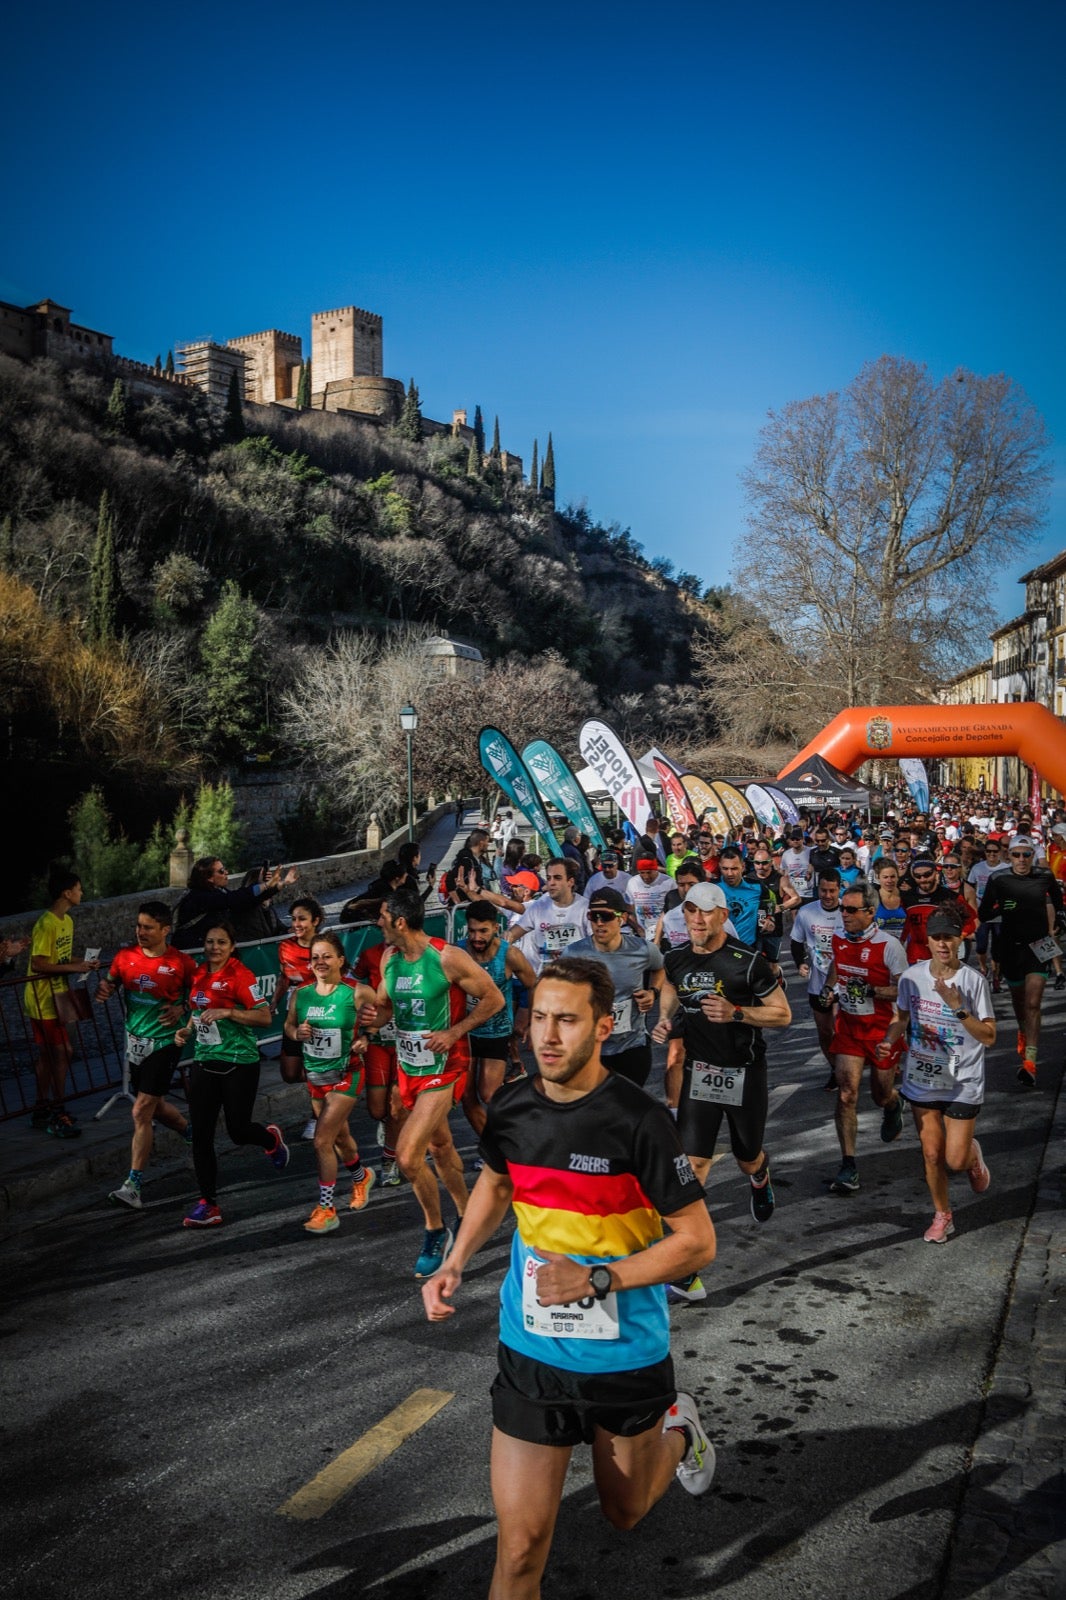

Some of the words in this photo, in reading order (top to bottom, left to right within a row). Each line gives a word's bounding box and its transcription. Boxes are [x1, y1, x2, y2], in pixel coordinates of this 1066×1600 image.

[896, 726, 958, 734] AYUNTAMIENTO
[966, 733, 1003, 741] Deportes
[548, 928, 576, 939] 3147
[841, 993, 865, 1004] 393
[133, 1044, 145, 1053] 17
[400, 1040, 421, 1052] 401
[916, 1061, 942, 1075] 292
[702, 1074, 734, 1089] 406
[569, 1153, 609, 1173] 226ERS
[551, 1312, 584, 1321] MARIANO
